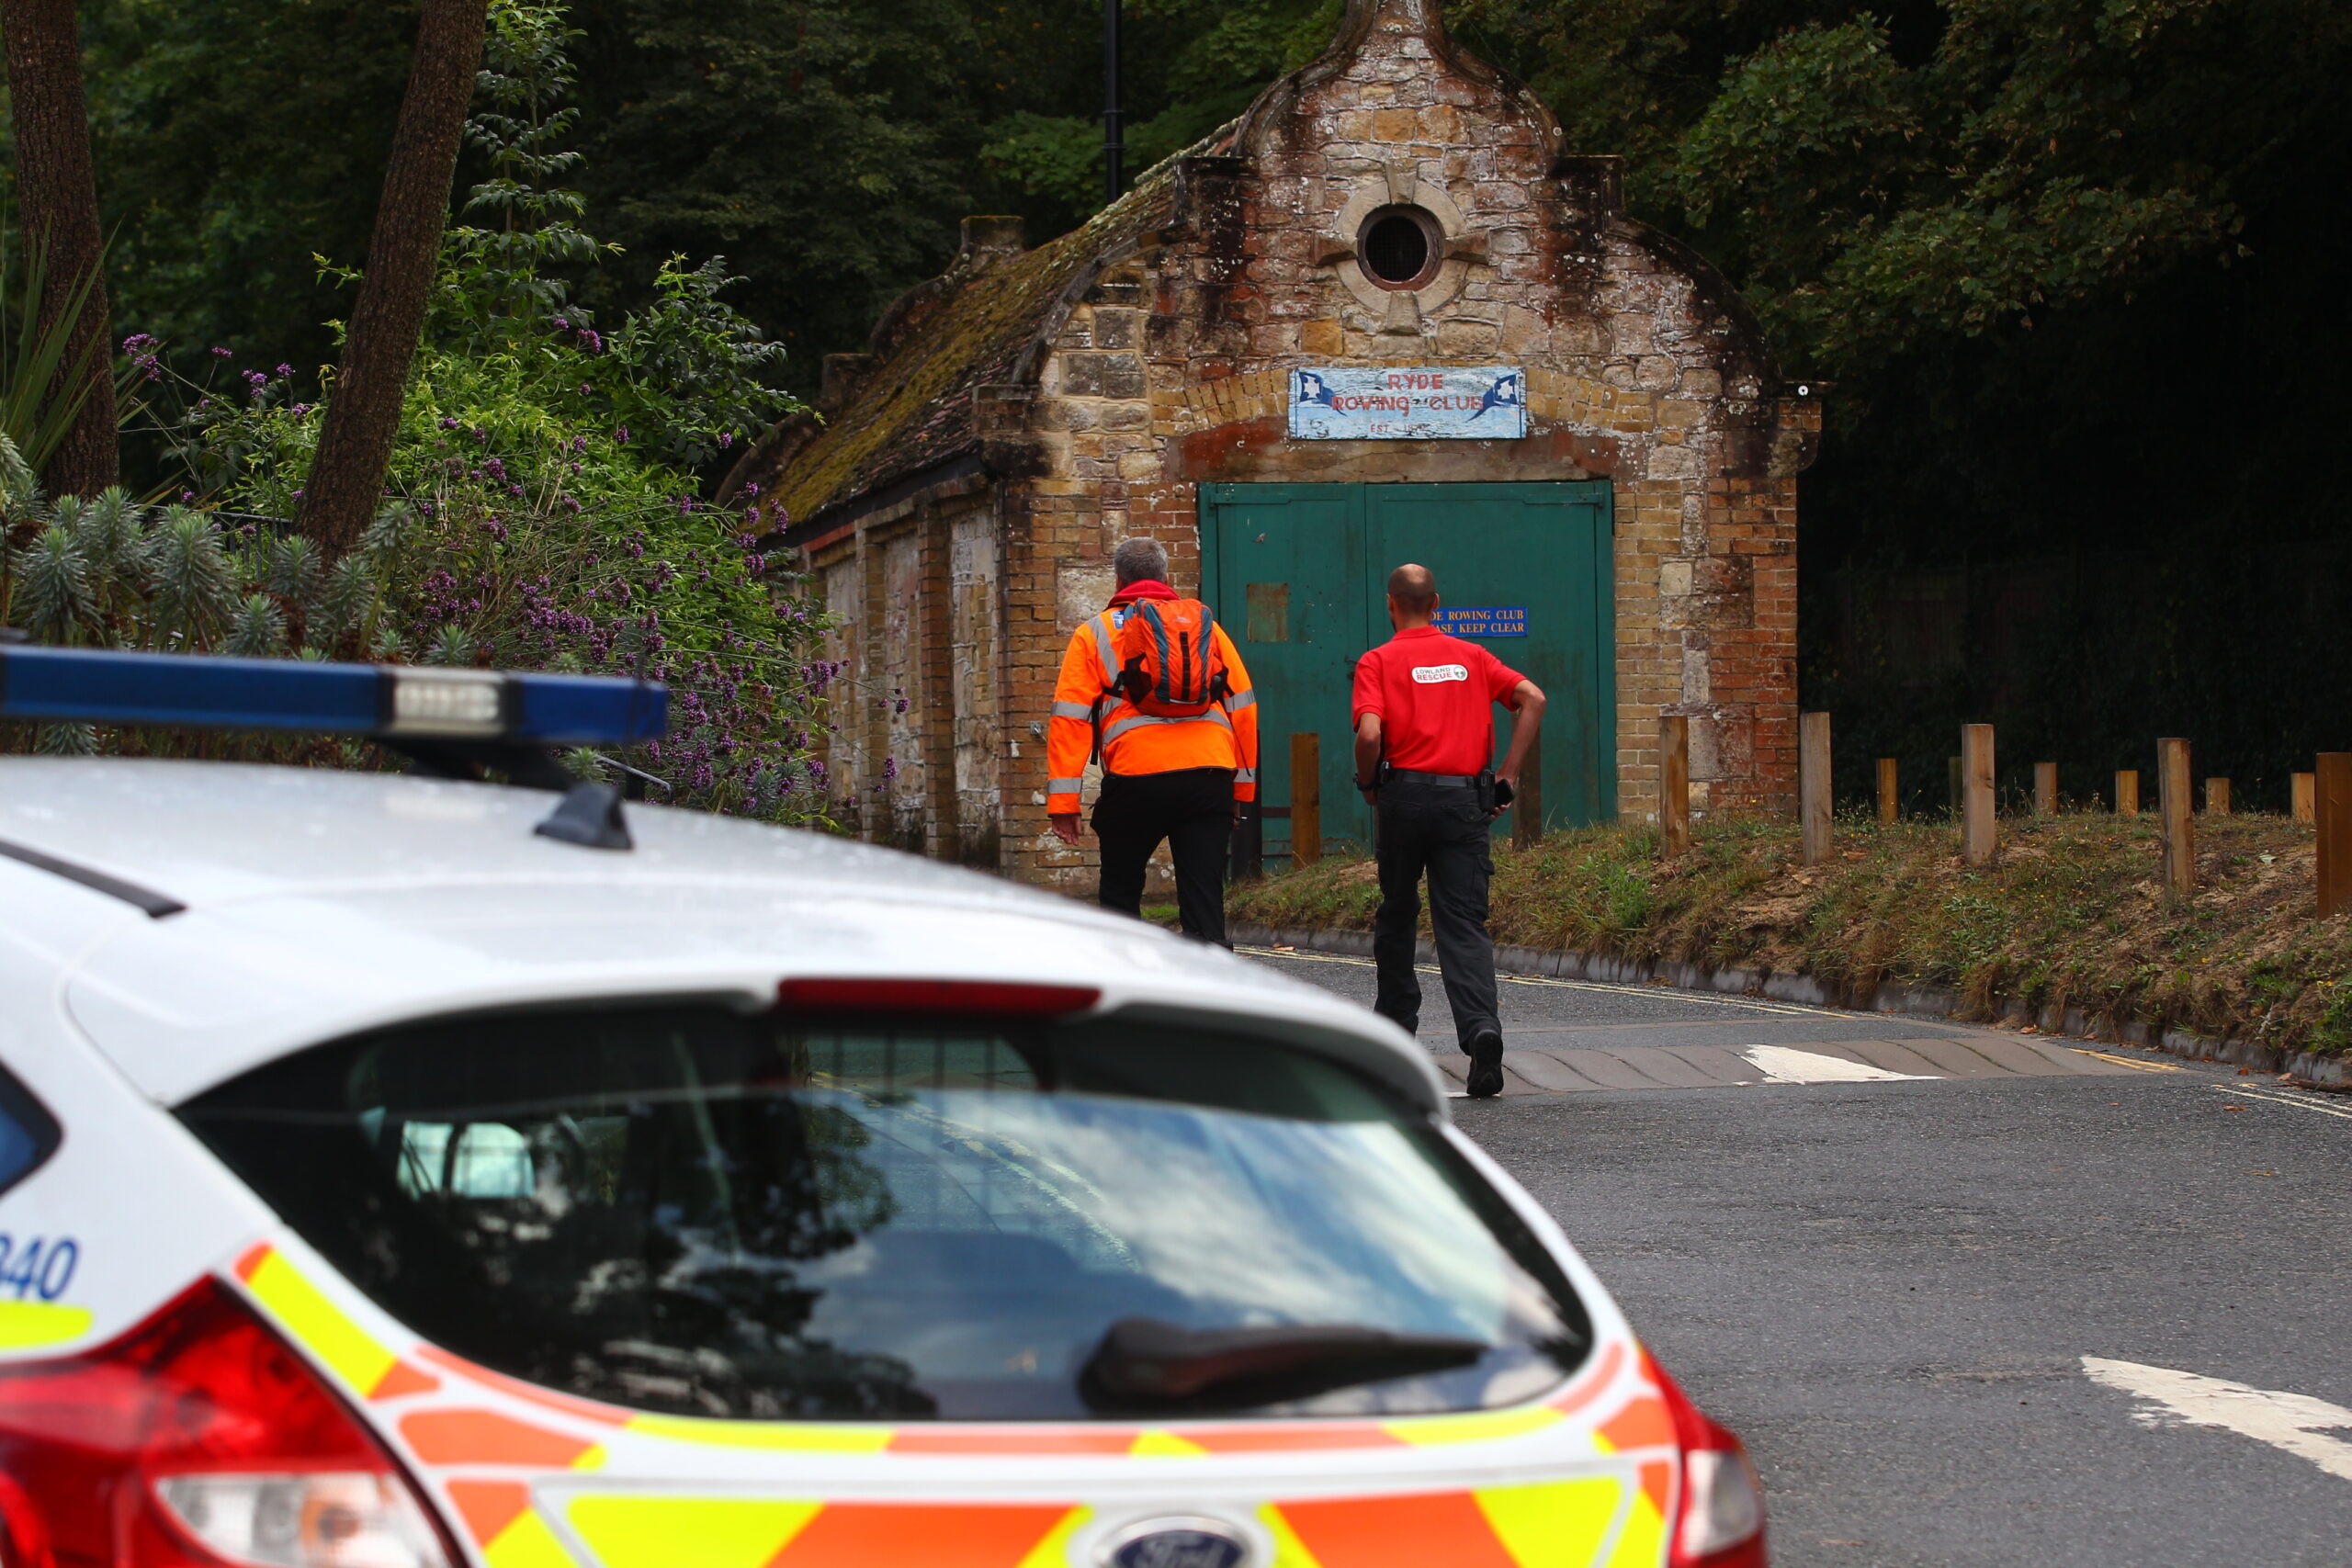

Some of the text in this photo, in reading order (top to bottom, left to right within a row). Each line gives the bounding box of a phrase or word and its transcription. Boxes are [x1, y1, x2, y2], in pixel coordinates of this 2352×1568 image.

[1387, 373, 1444, 390] RYDE
[1430, 396, 1484, 411] CLUB
[1448, 610, 1491, 621] ROWING
[1496, 609, 1524, 620] CLUB
[1459, 623, 1487, 633] KEEP
[1490, 622, 1525, 633] CLEAR
[1415, 667, 1451, 675] LOWLAND
[1416, 671, 1452, 681] RESCUE
